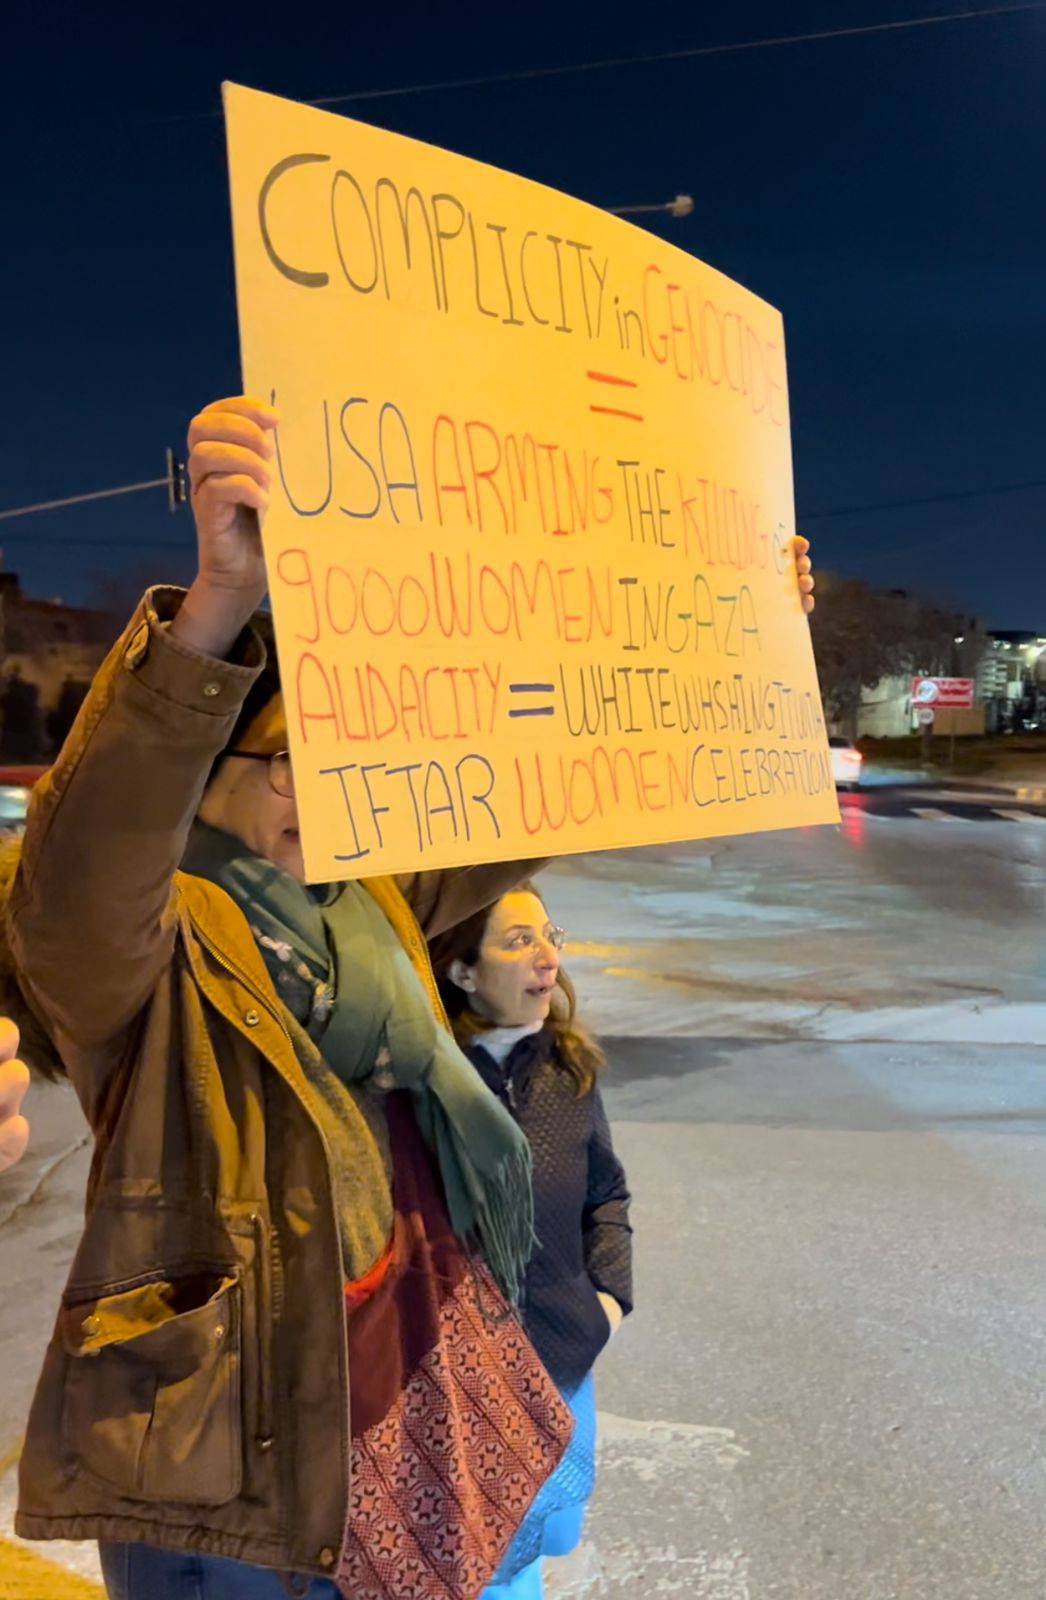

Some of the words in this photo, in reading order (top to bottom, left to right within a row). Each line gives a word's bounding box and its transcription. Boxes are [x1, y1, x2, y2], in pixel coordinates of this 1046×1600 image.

[258, 152, 609, 340] COMPLICITY
[613, 295, 645, 358] in
[643, 264, 784, 426] GENOCIDE
[270, 388, 423, 524] USA
[431, 413, 614, 536] ARMING
[616, 459, 676, 547] THE
[677, 471, 769, 571] KILLING
[276, 548, 430, 644] 9000
[430, 551, 613, 643] WOMEN
[618, 577, 661, 651] IN
[664, 573, 762, 657] GAZA
[296, 652, 502, 743] AUDACITY
[318, 754, 502, 860] IFTAR
[514, 746, 690, 834] WOMEN
[690, 744, 831, 807] CELEBRATION
